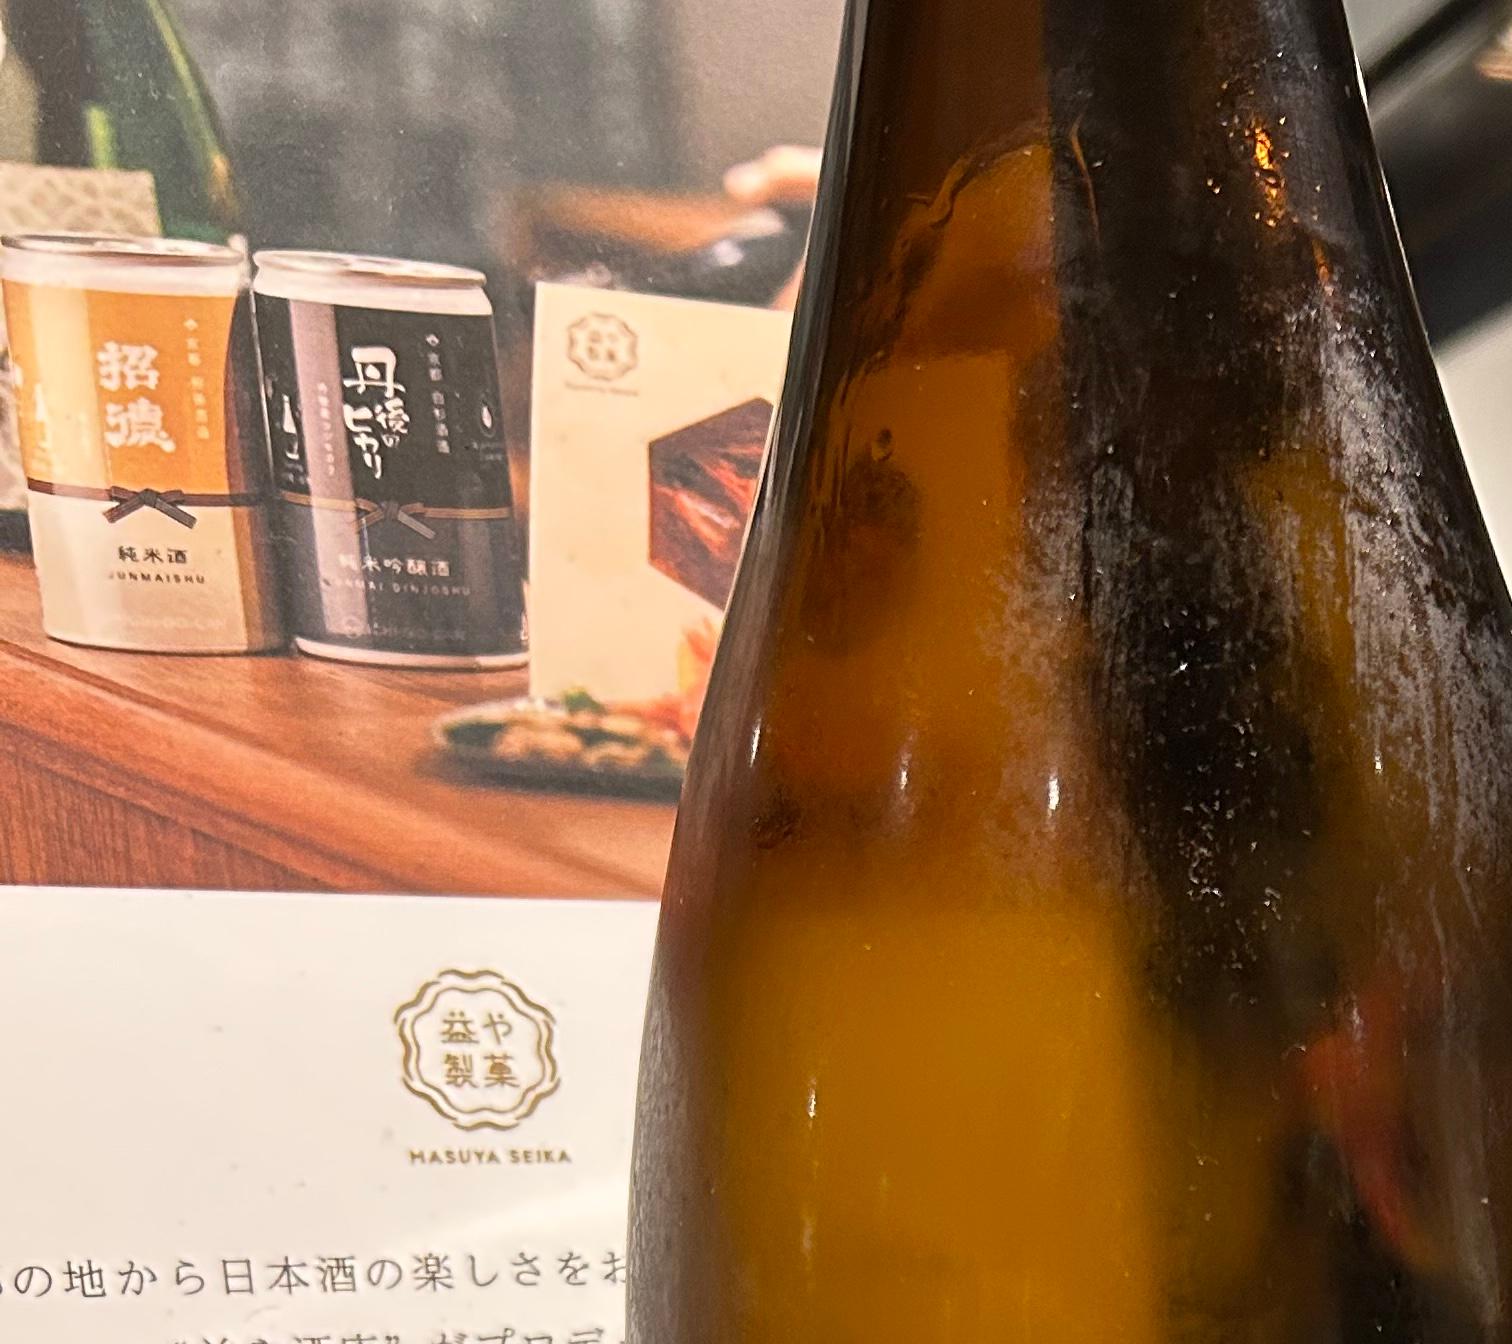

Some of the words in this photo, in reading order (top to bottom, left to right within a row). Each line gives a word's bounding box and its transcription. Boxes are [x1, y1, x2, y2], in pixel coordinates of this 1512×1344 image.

[117, 545, 188, 565] 純米酒
[441, 1011, 515, 1045] 益や
[443, 1053, 520, 1089] 製菓
[409, 1149, 500, 1165] MASUYA
[509, 1149, 573, 1165] SEIKA
